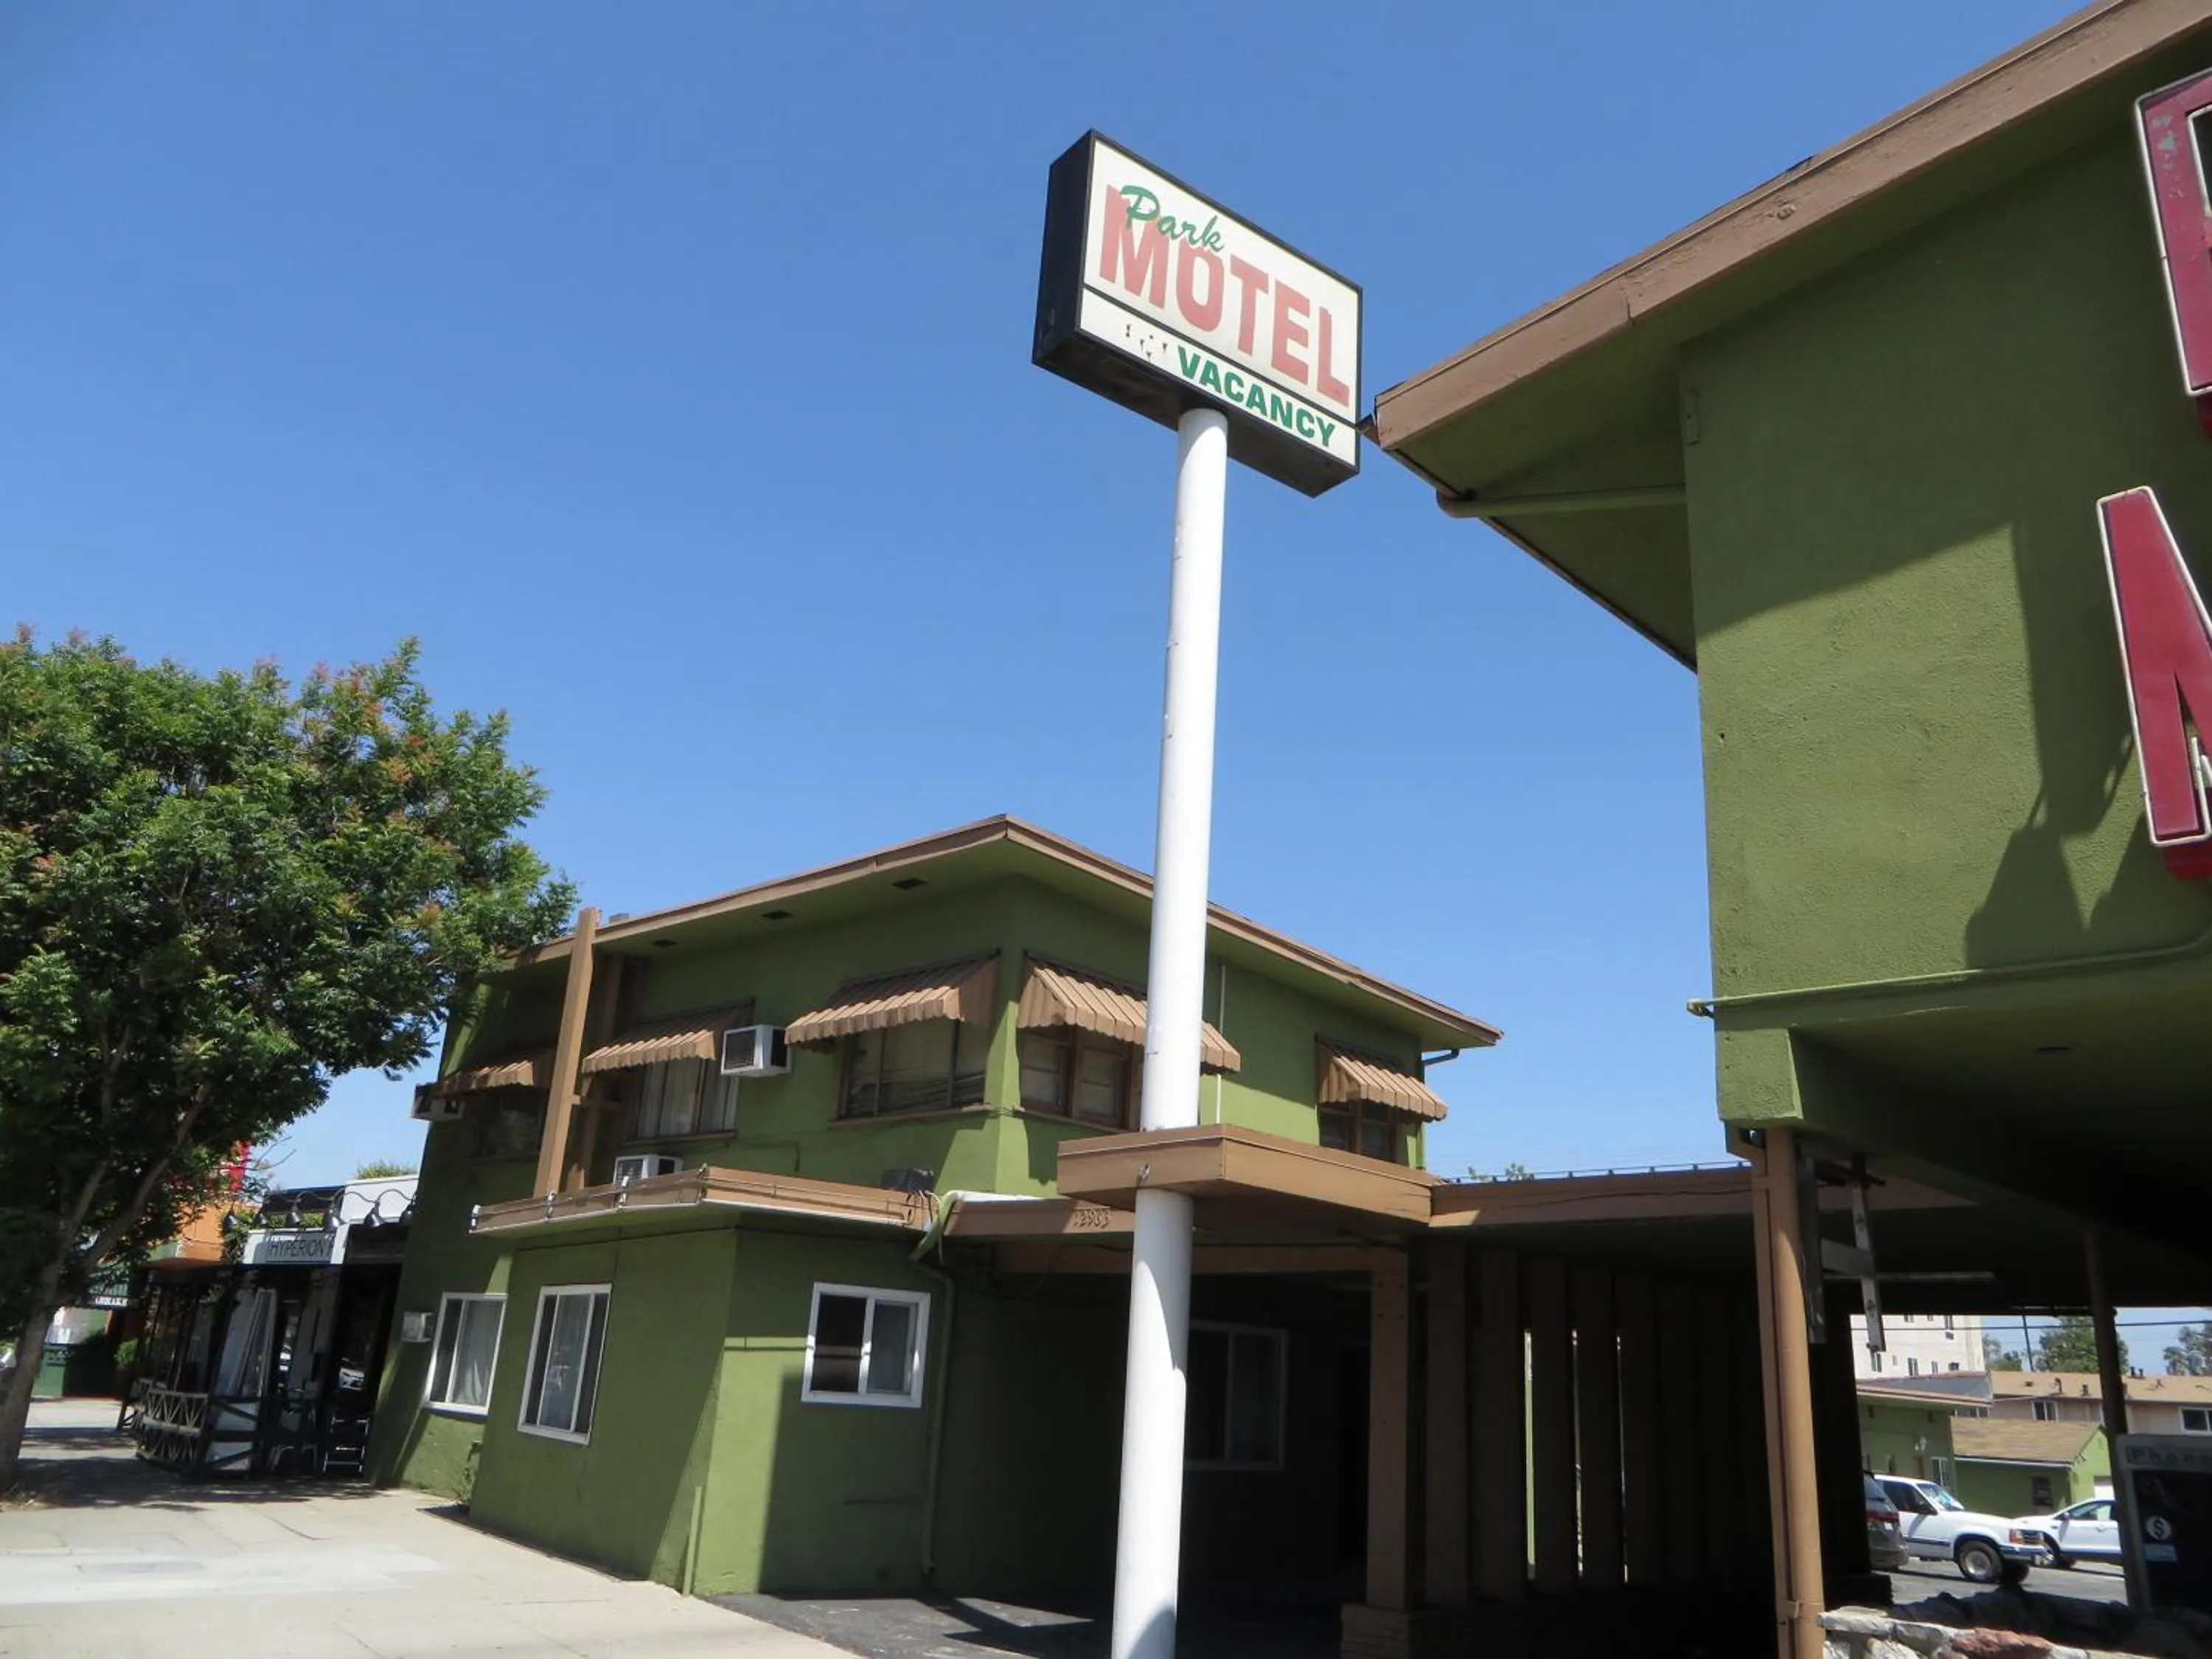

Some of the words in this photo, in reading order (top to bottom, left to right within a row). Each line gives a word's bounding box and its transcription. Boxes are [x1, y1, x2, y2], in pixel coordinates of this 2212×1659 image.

[1119, 184, 1225, 252] Park
[1099, 184, 1349, 406] MOTEL
[1178, 346, 1335, 447] VACANCY
[269, 1237, 324, 1257] HYPERION
